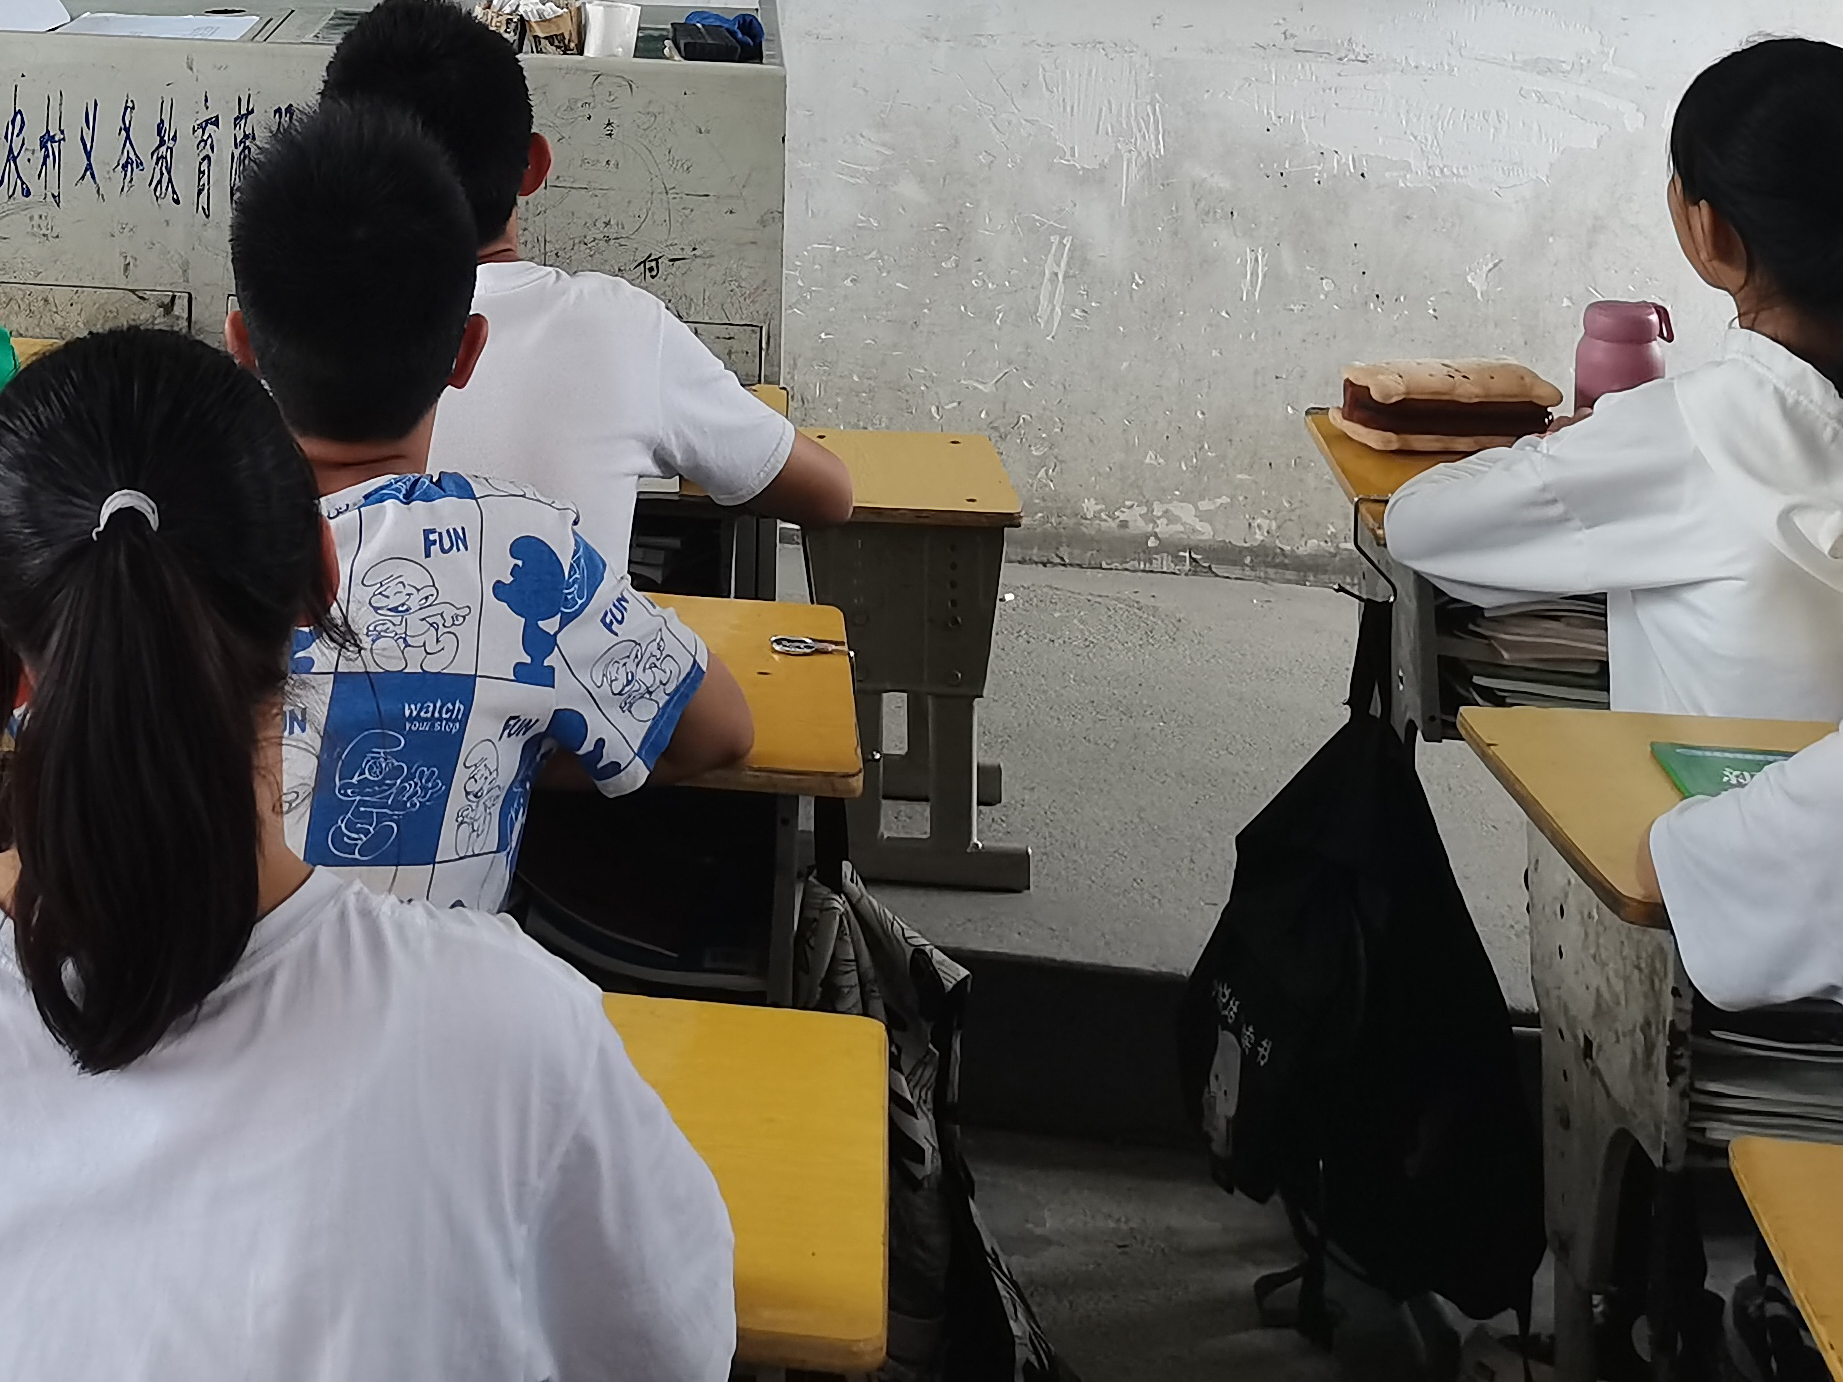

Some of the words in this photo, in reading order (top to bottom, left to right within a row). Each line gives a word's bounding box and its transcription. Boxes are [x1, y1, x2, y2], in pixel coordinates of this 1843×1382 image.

[422, 526, 469, 558] FUN
[600, 594, 632, 637] FUN
[404, 698, 465, 720] watch
[404, 720, 431, 734] your
[498, 715, 540, 742] FUN
